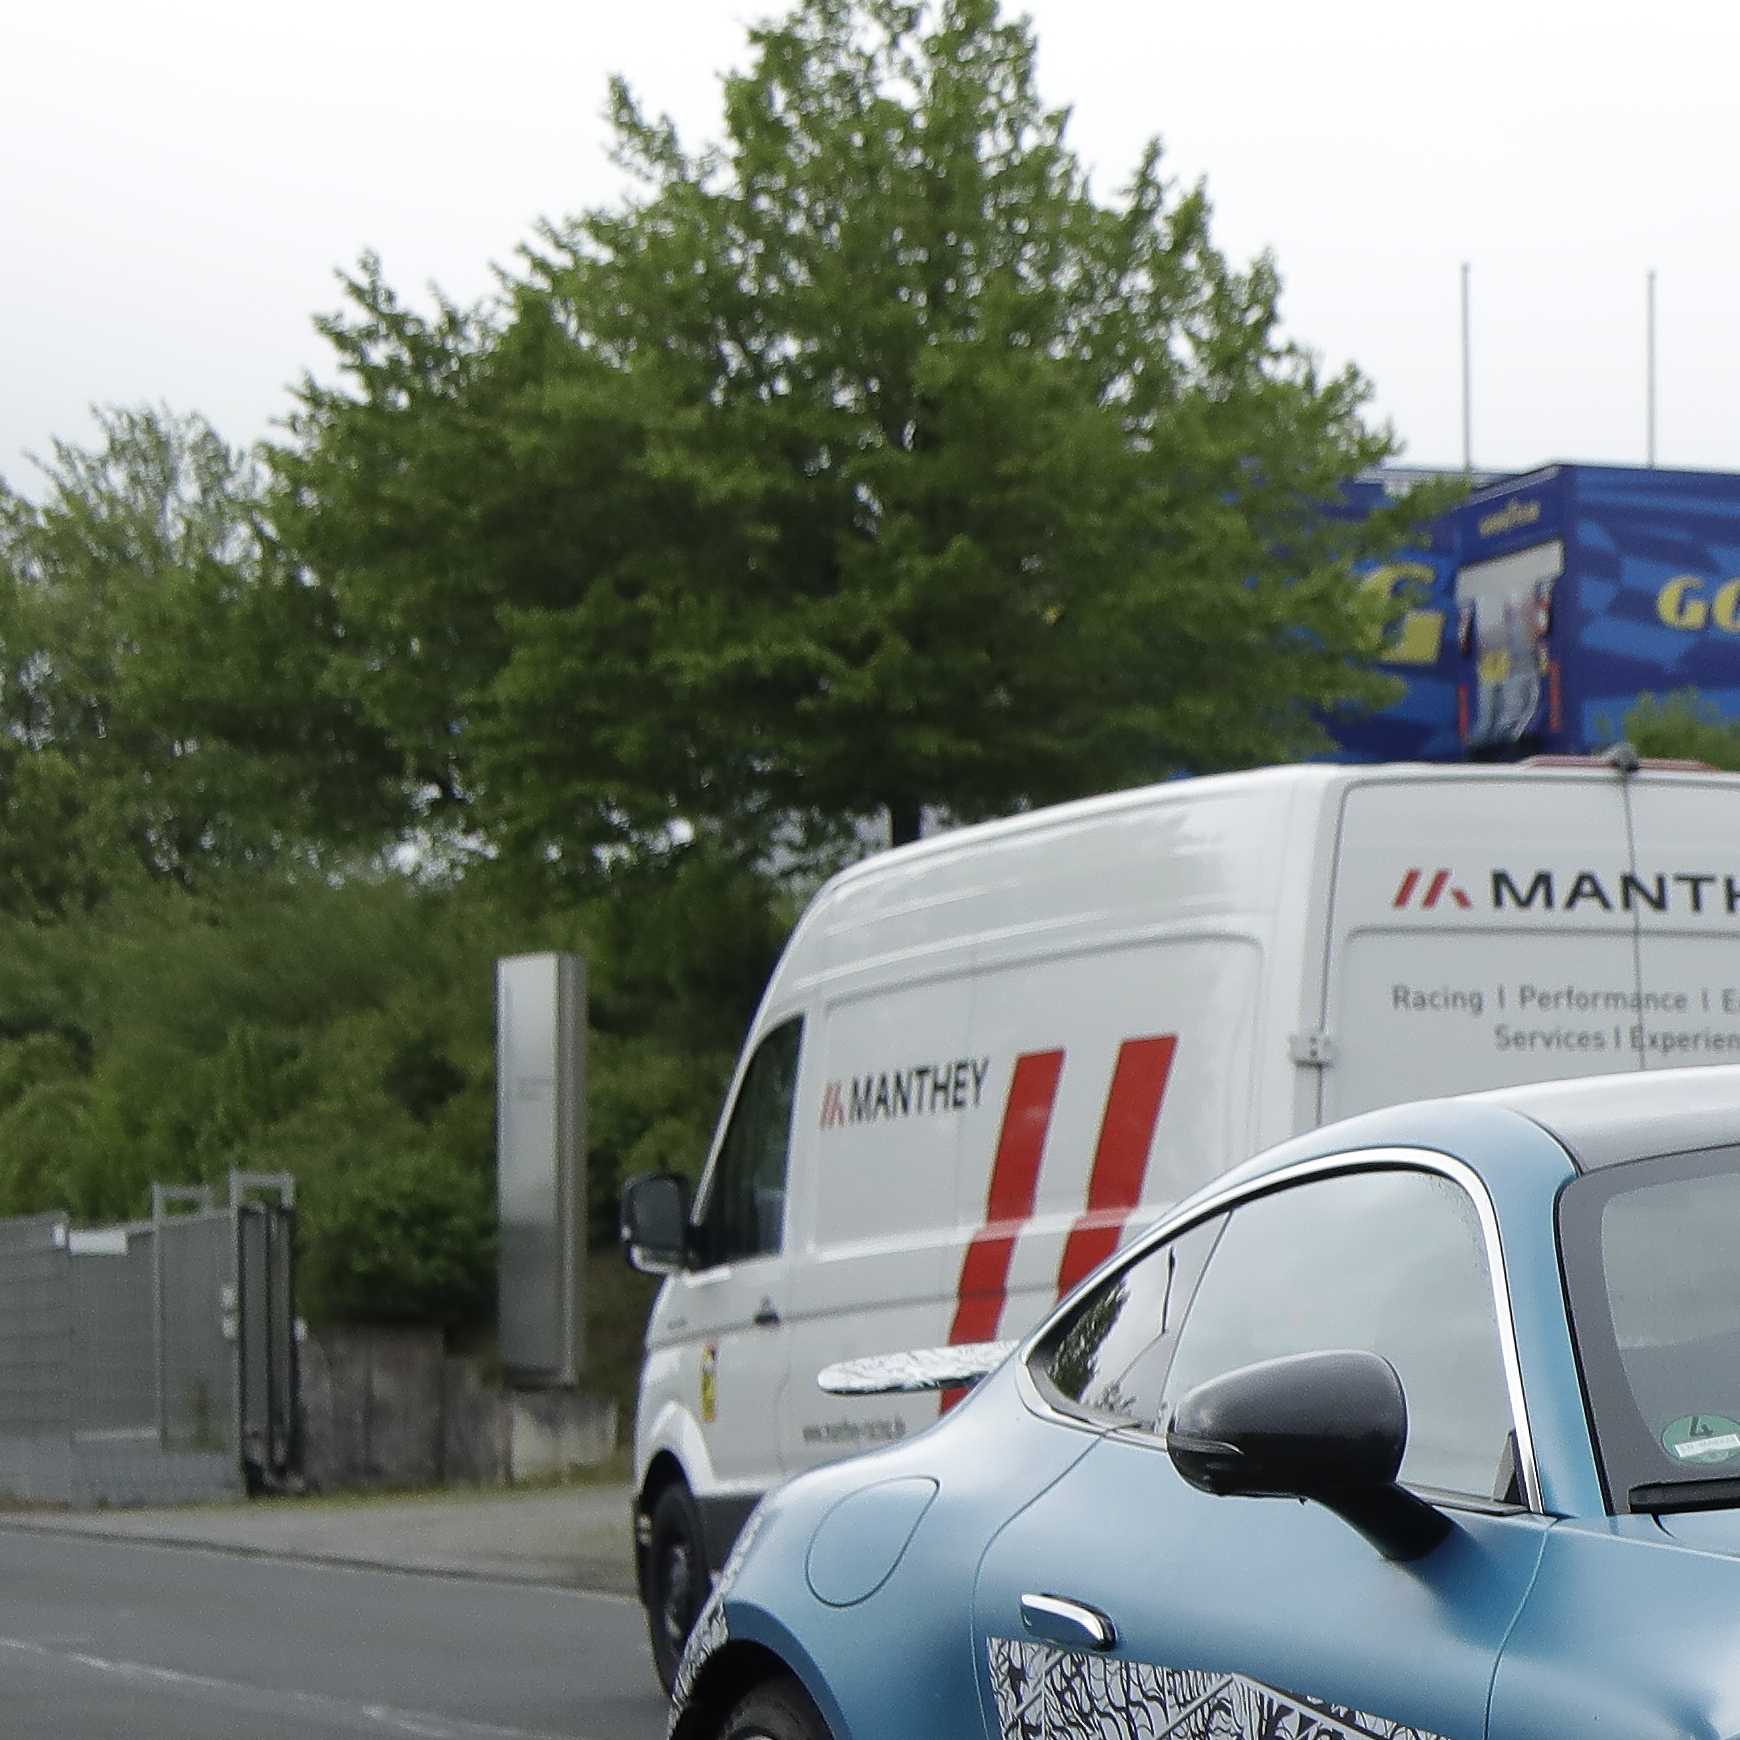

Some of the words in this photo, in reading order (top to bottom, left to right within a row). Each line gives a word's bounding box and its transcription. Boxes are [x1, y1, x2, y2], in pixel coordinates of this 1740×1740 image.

[1390, 983, 1484, 1017] Racing
[1518, 983, 1689, 1013] Performance
[1493, 1024, 1608, 1051] Services
[849, 1055, 990, 1124] MANTHEY
